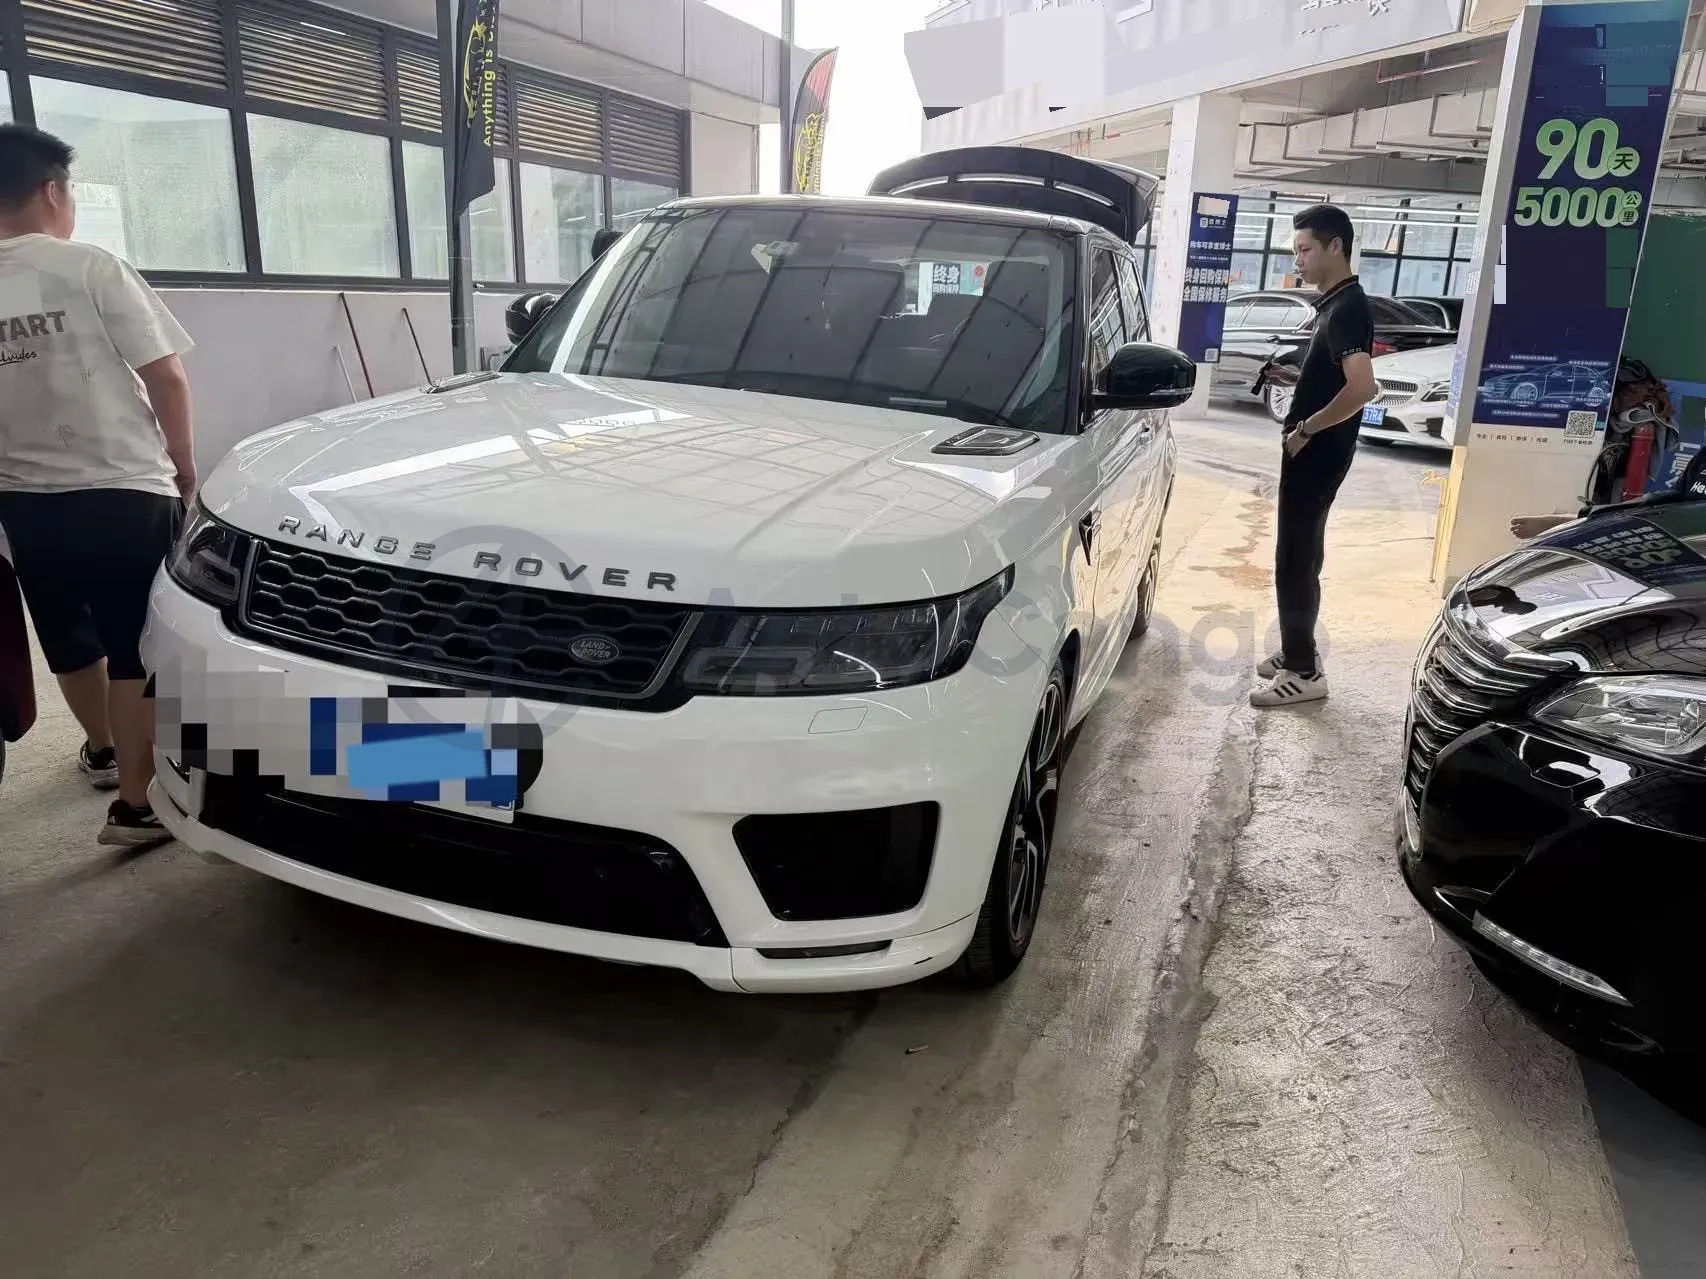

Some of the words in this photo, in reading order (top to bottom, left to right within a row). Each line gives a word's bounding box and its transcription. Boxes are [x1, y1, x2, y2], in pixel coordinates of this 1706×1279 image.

[485, 50, 494, 63] is
[482, 70, 495, 146] Anything
[933, 264, 960, 284] 终身
[278, 515, 437, 562] RANGE
[472, 551, 678, 592] ROVER
[582, 649, 610, 658] ROVER
